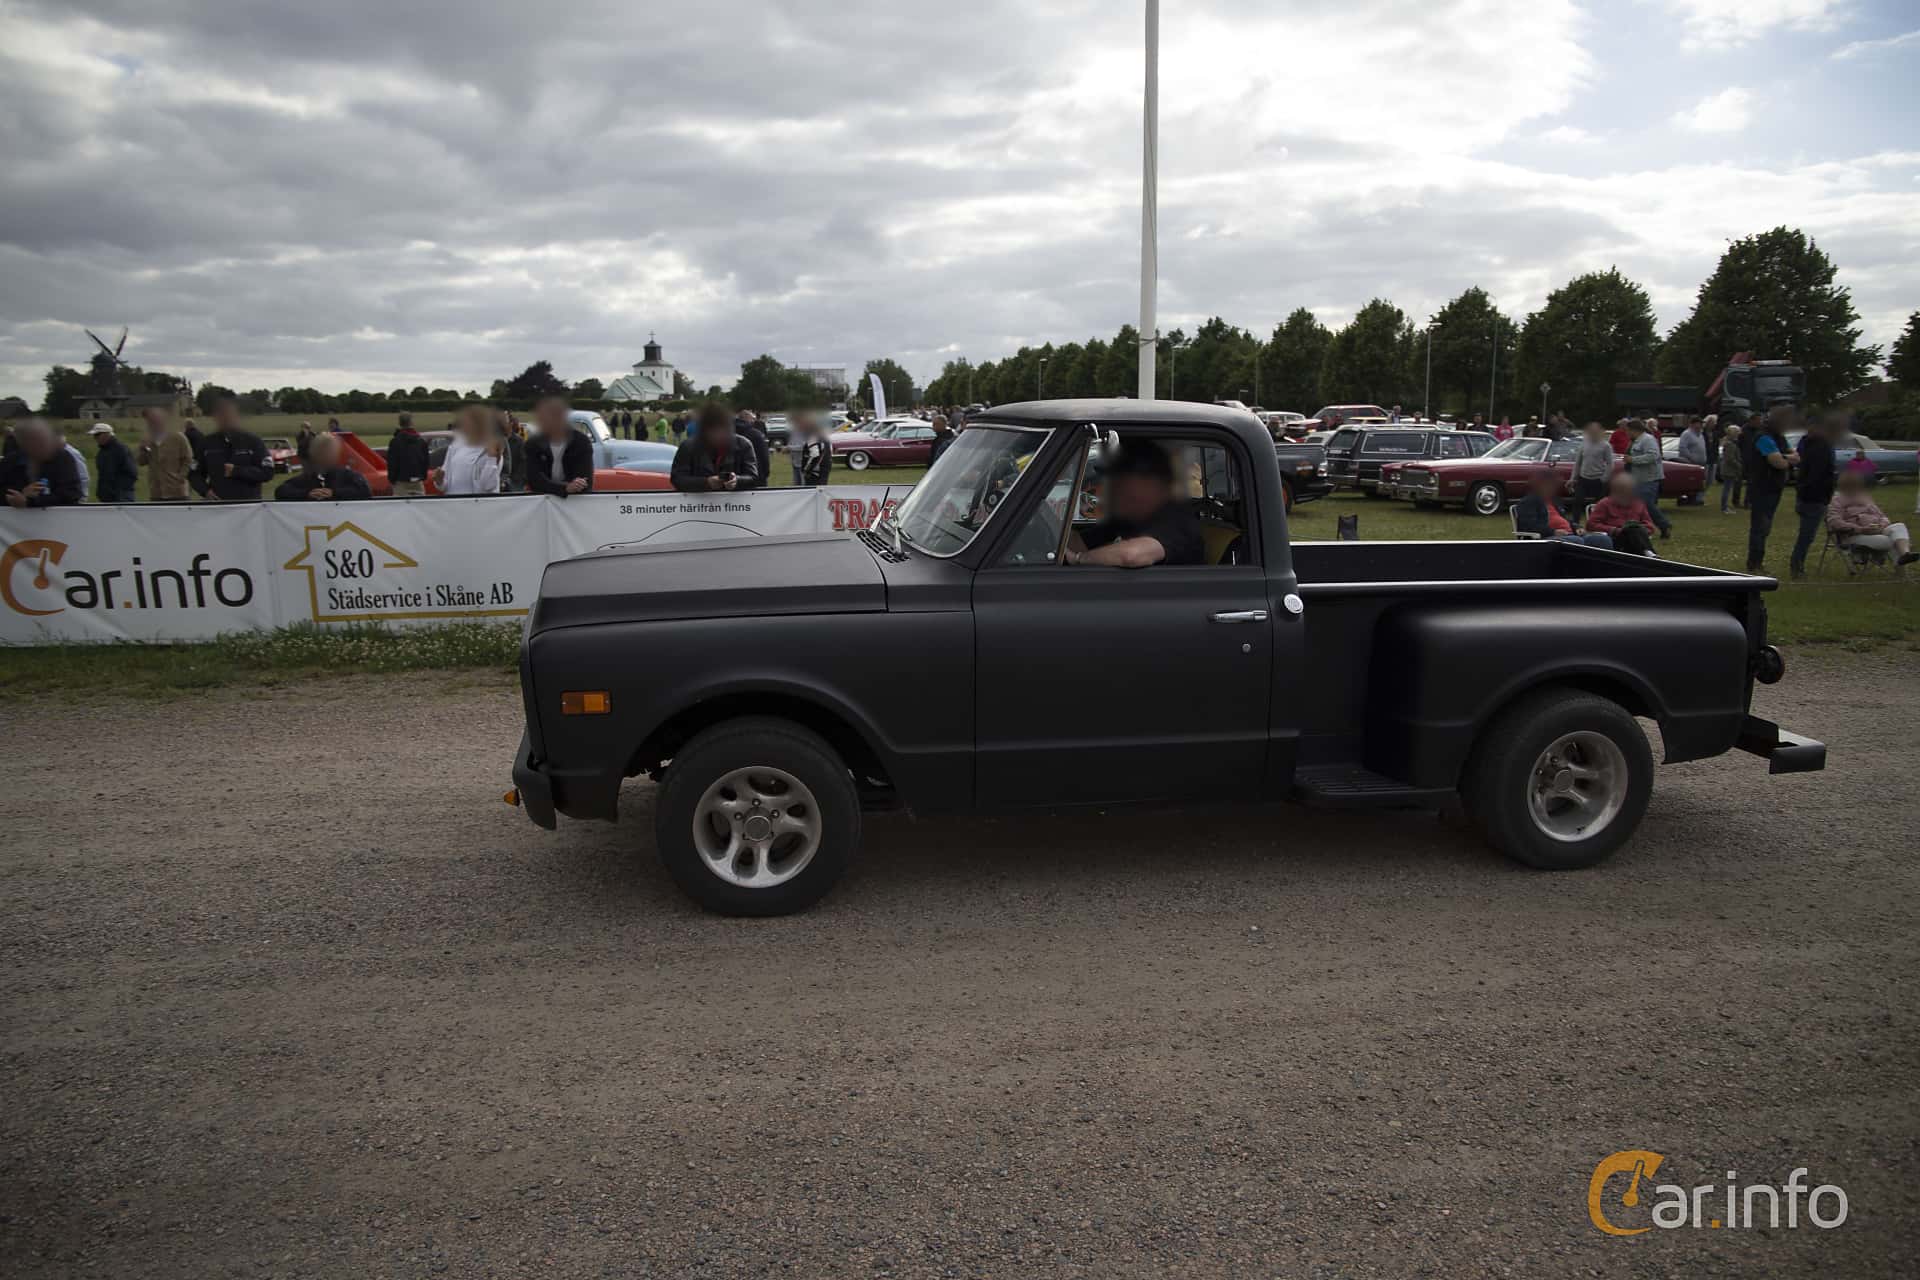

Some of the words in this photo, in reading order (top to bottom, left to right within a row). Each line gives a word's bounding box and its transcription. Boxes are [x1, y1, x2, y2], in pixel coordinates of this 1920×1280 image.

[620, 505, 633, 514] 38
[635, 504, 677, 514] minuter
[680, 502, 721, 513] härifrån
[724, 502, 752, 512] finns
[0, 539, 254, 616] Car.info
[324, 548, 375, 579] S&O
[327, 586, 423, 610] Städservice
[425, 586, 433, 607] i
[435, 584, 486, 607] Skåne
[490, 582, 515, 605] AB
